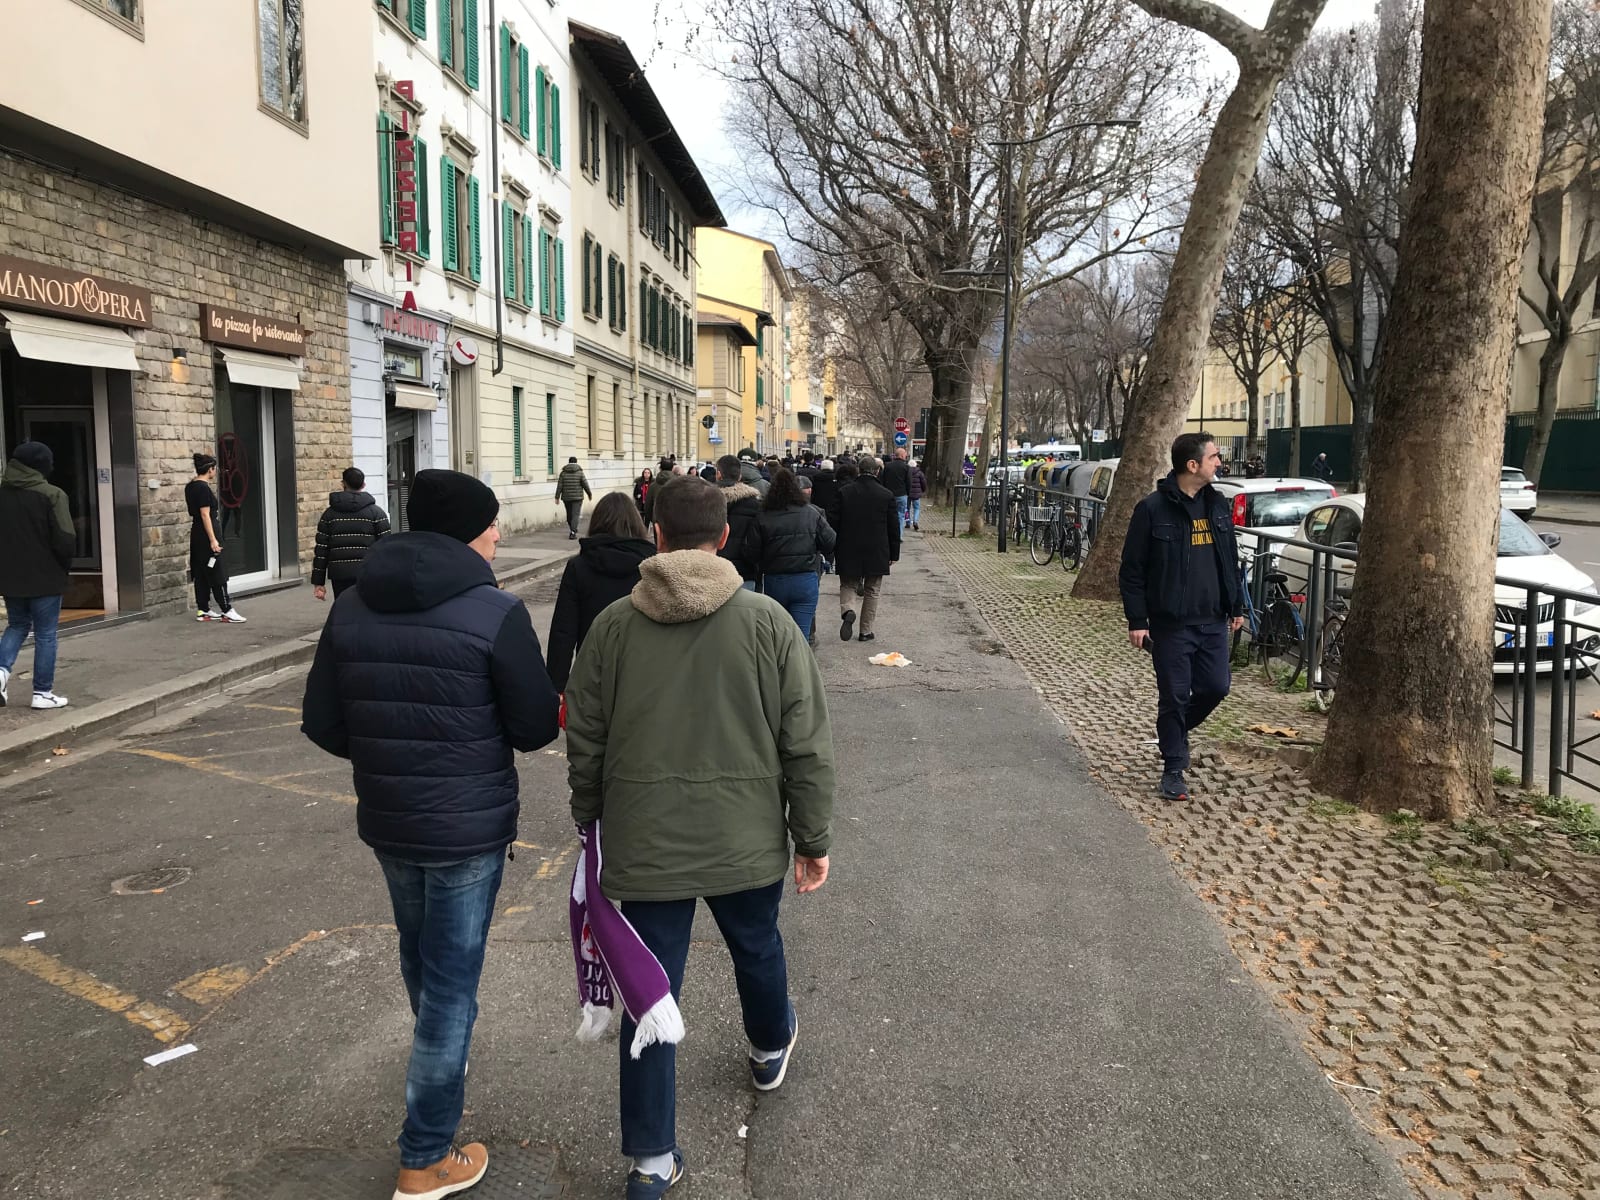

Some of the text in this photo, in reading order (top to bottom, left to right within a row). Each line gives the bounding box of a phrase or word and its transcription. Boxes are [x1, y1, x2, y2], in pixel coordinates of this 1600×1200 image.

[211, 310, 303, 344] la pizza fa ristorante
